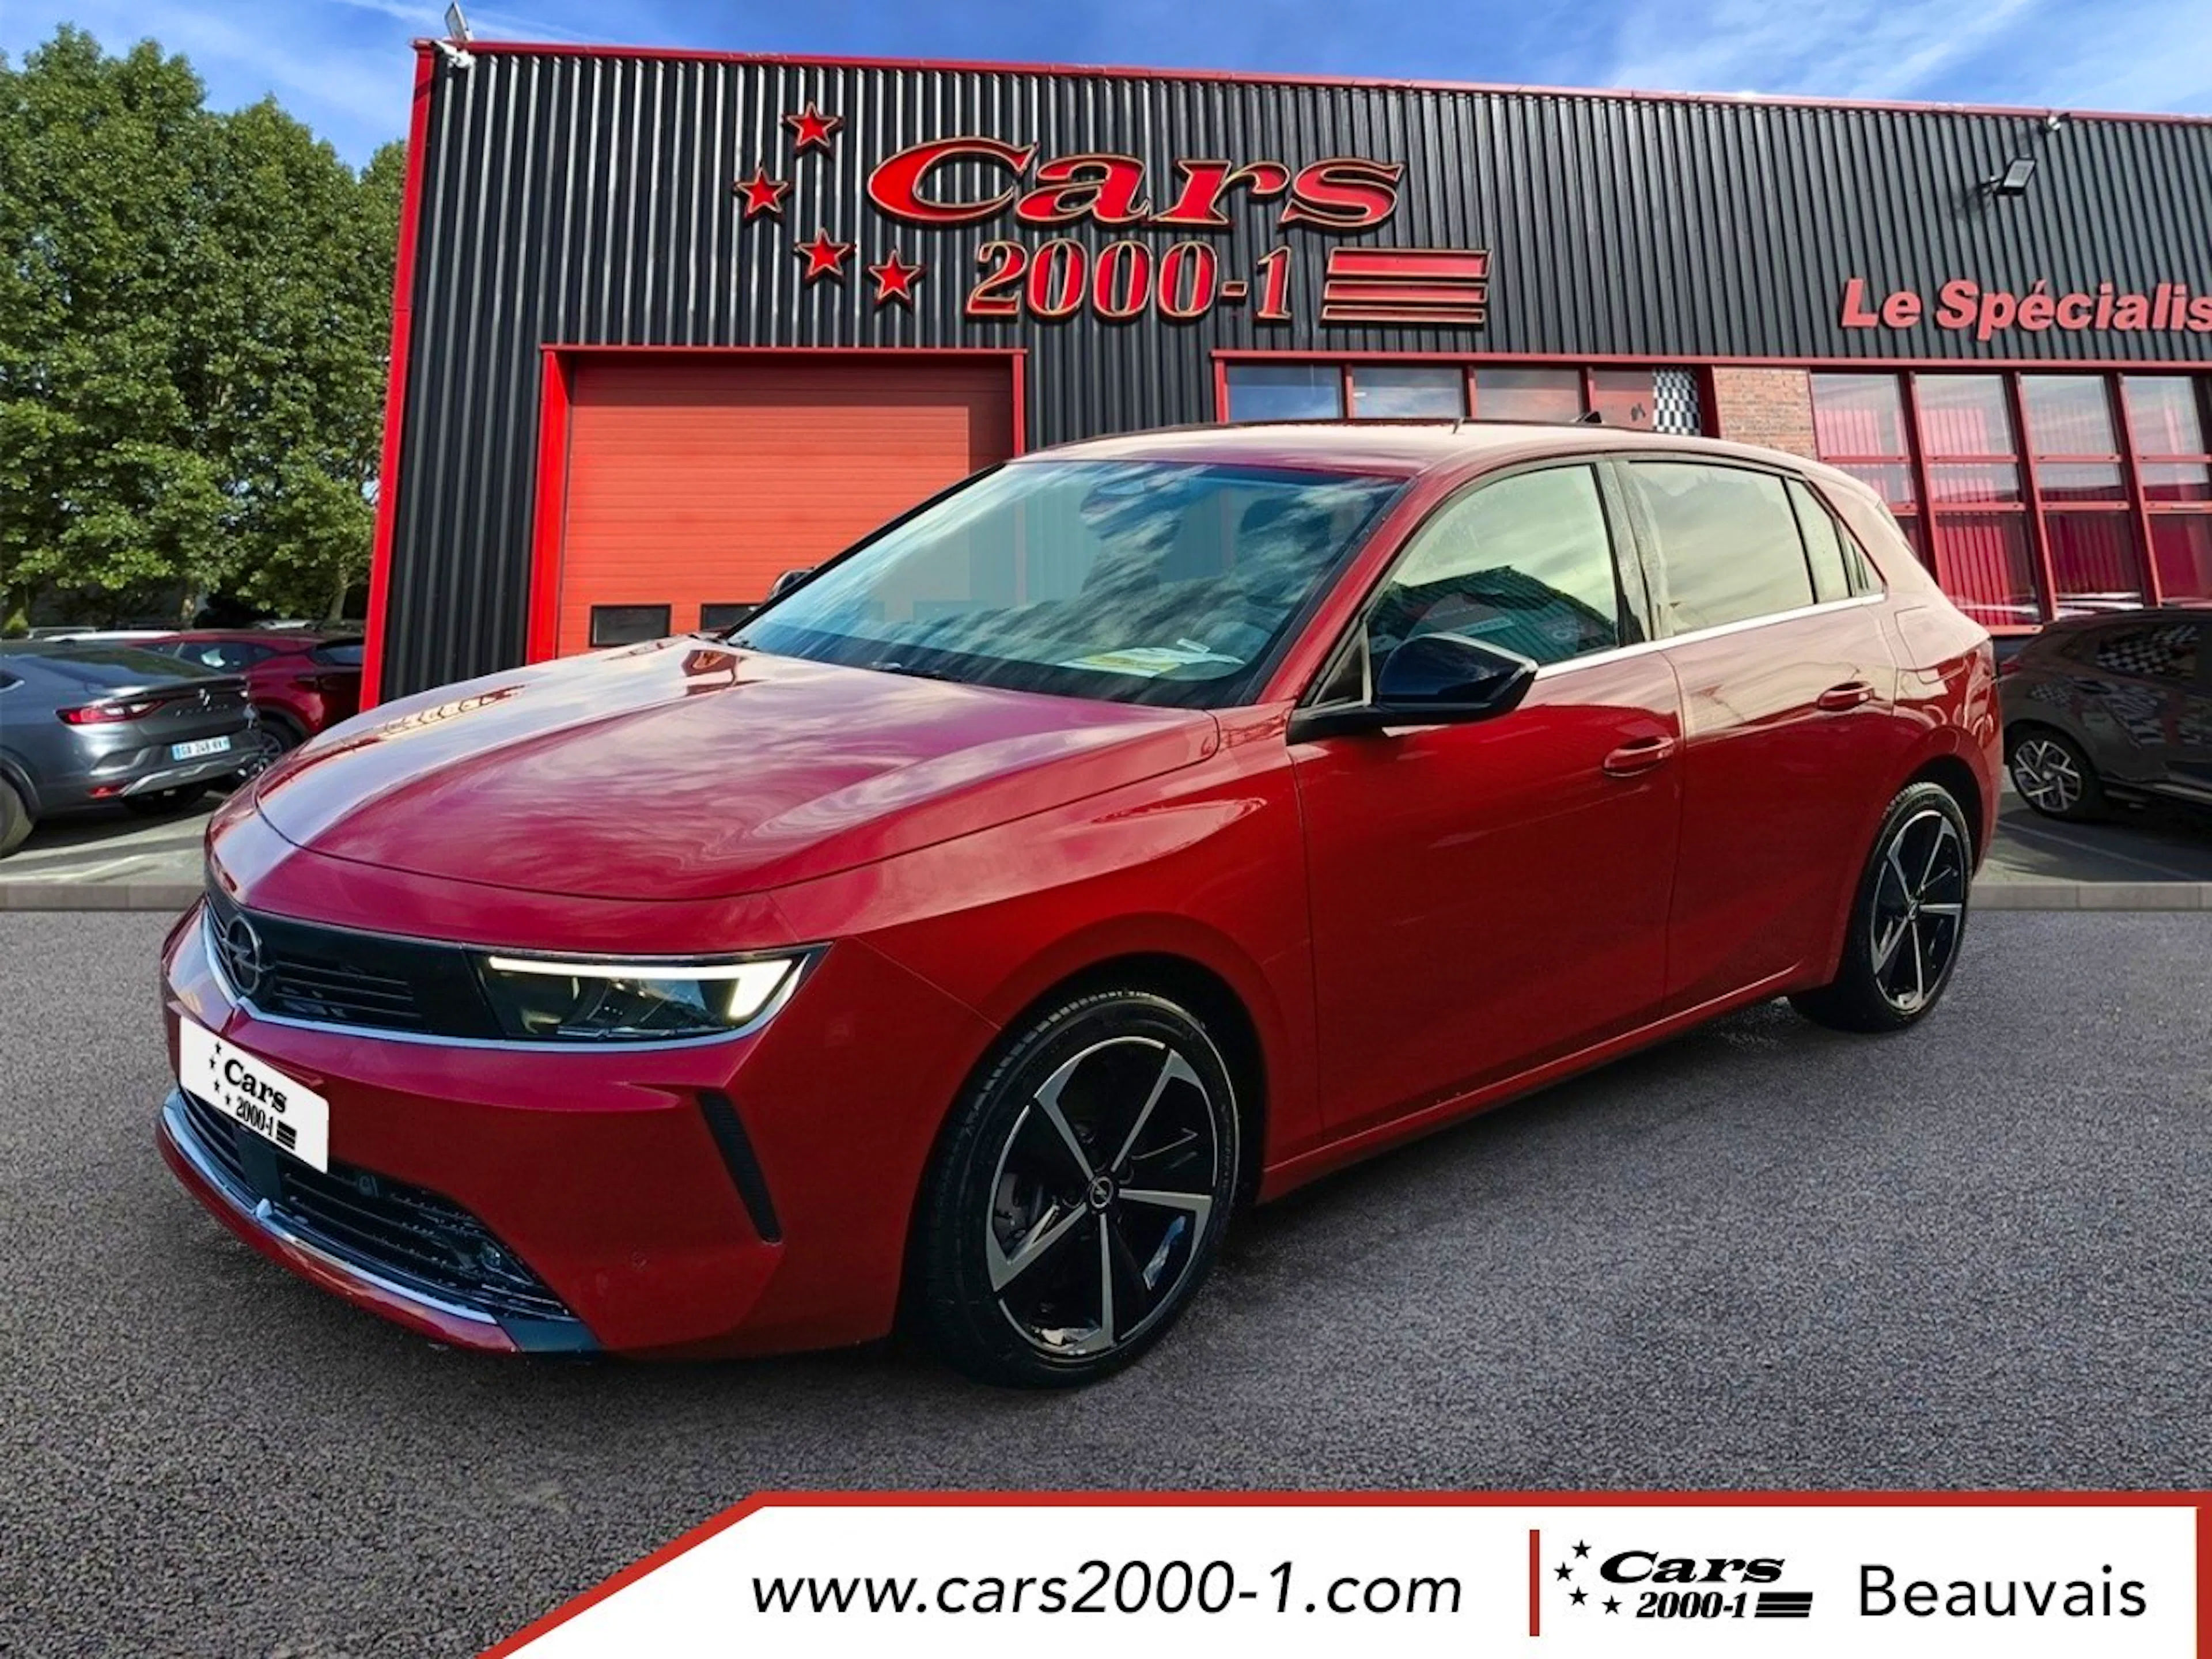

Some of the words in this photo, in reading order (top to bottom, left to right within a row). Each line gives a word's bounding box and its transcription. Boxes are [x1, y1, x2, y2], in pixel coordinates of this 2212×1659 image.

[867, 136, 1404, 226] Cars
[965, 239, 1292, 322] 2000-1
[1842, 279, 1922, 329] Le
[225, 1059, 288, 1113] Cars
[236, 1097, 275, 1137] 2000-1
